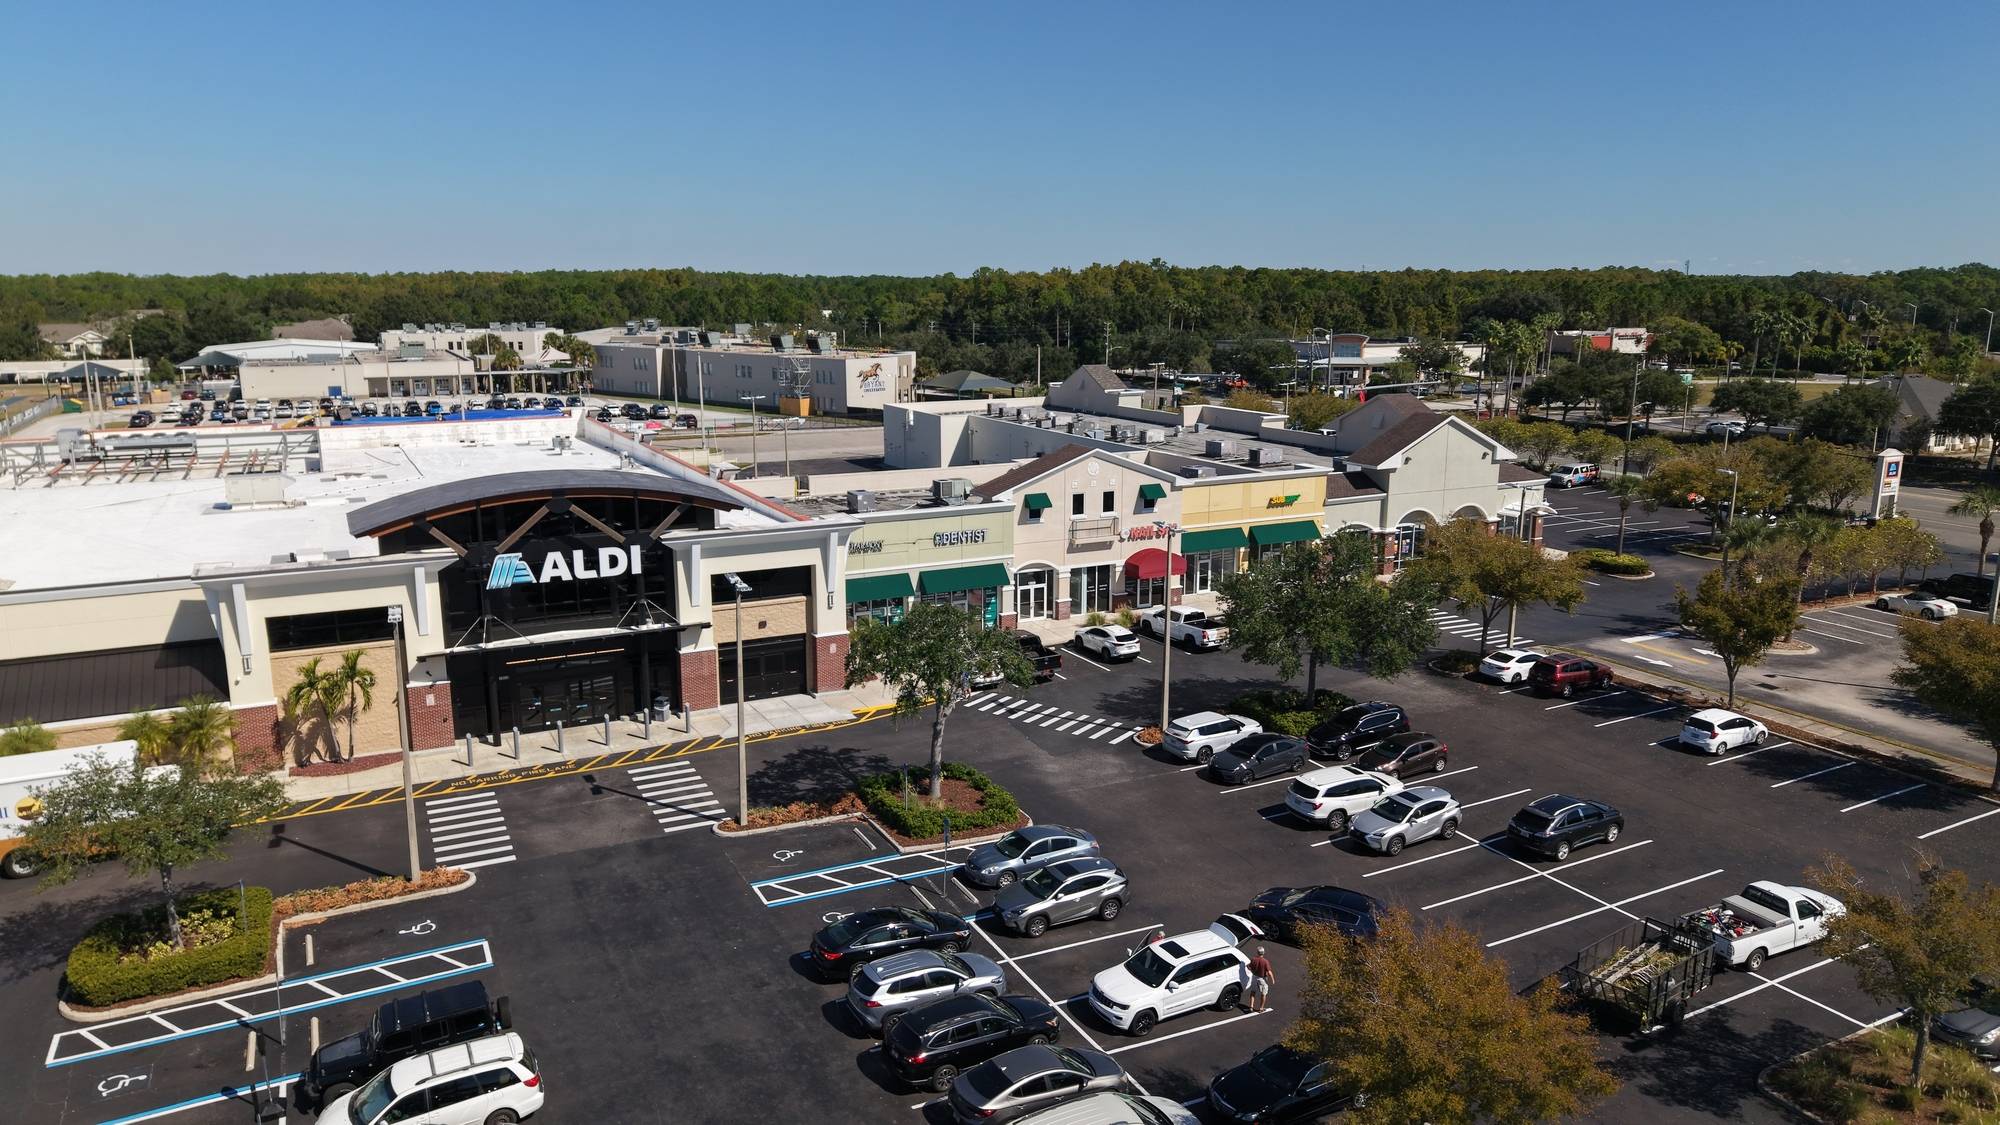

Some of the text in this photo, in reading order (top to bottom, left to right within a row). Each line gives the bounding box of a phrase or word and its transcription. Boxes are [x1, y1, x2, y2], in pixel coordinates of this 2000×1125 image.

[942, 528, 988, 546] DENTIST
[539, 544, 642, 584] ALDI
[469, 773, 516, 784] PARKING
